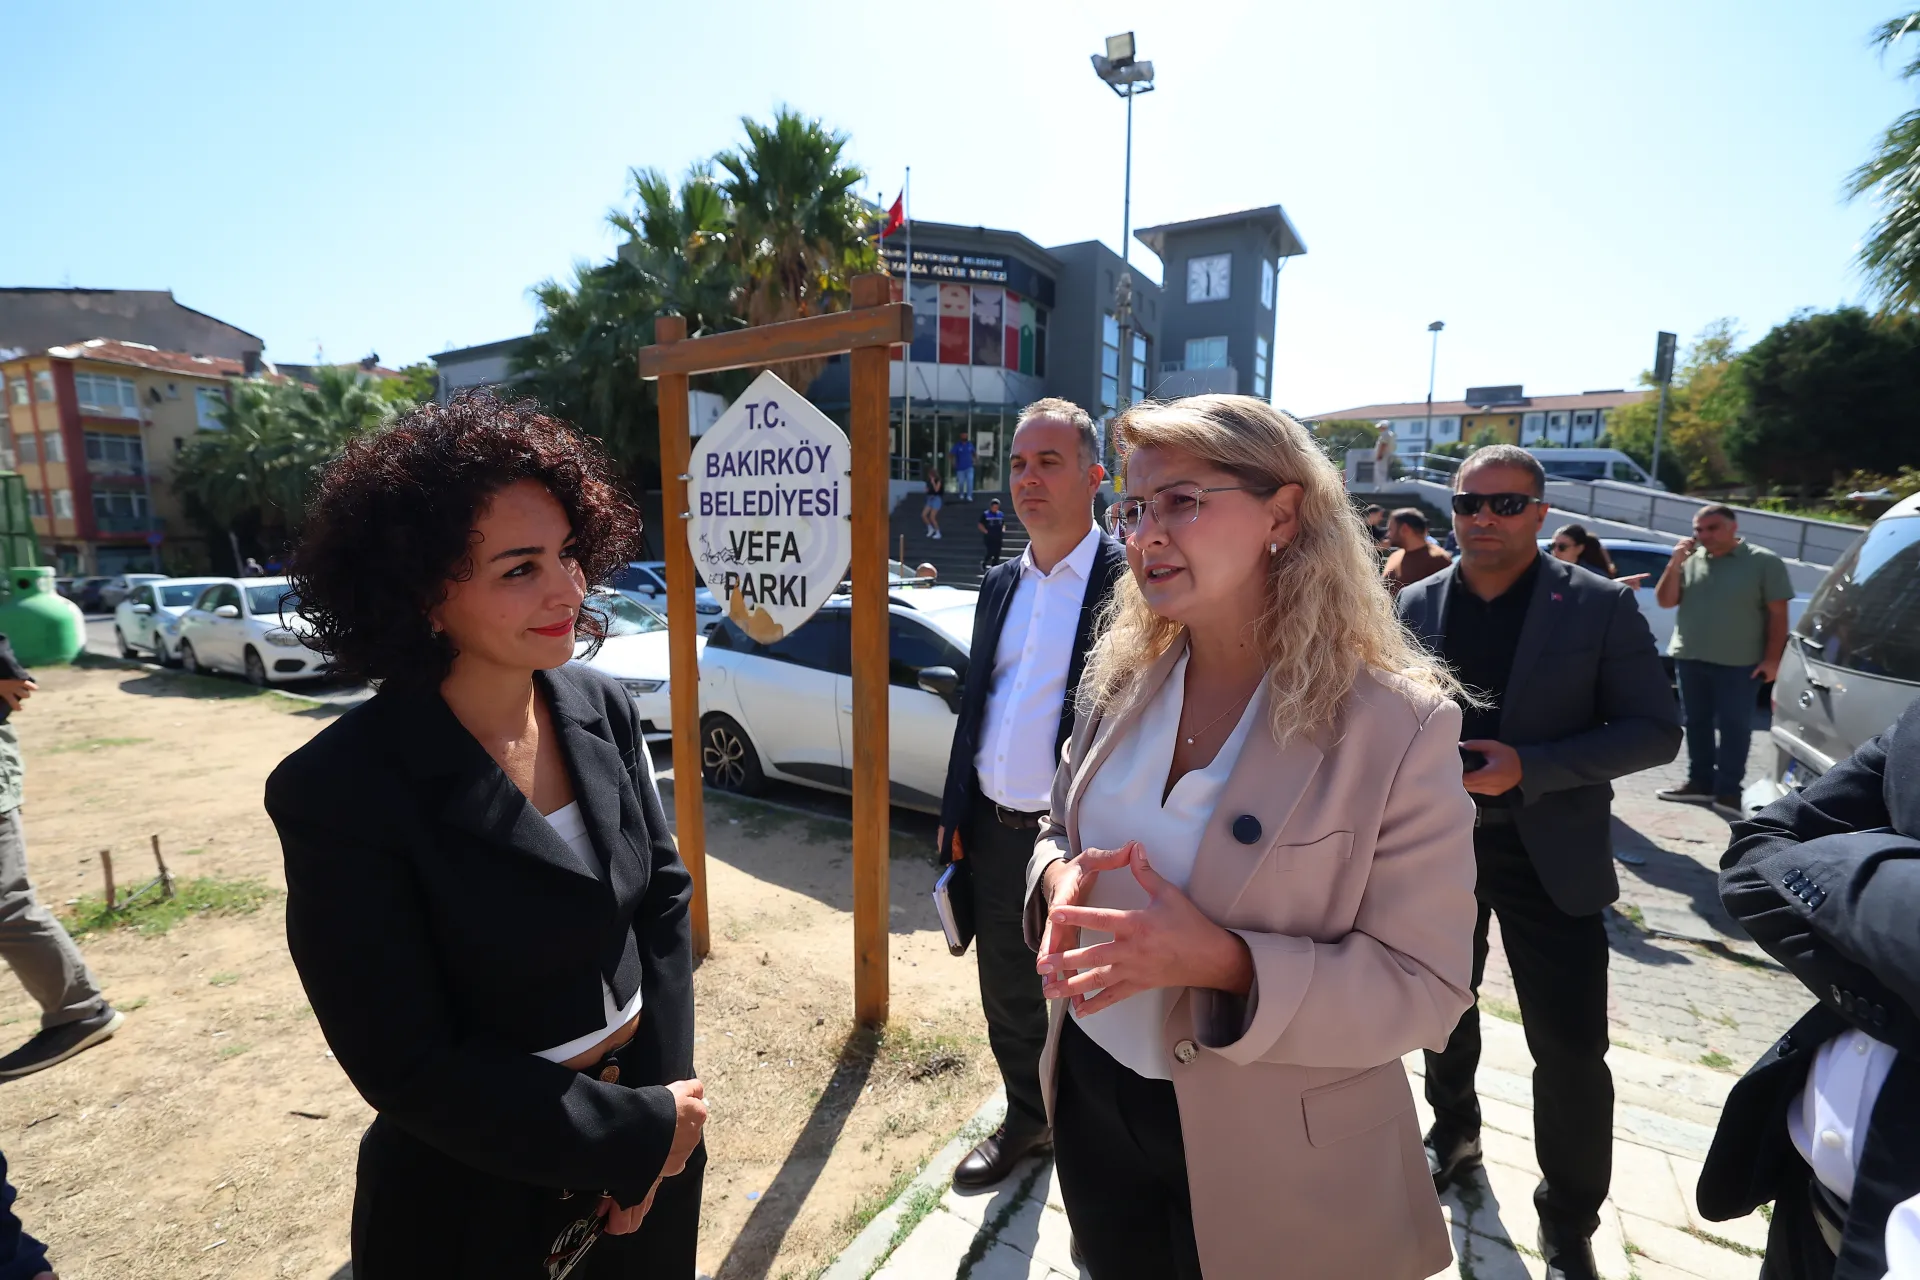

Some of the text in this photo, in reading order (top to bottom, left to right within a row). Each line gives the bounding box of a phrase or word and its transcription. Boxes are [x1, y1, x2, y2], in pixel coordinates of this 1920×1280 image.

[745, 400, 786, 430] T.C.
[706, 439, 832, 478] BAKIRKÖY
[700, 480, 839, 516] BELEDİYESİ
[729, 530, 801, 564] VEFA
[724, 571, 807, 608] PARKI
